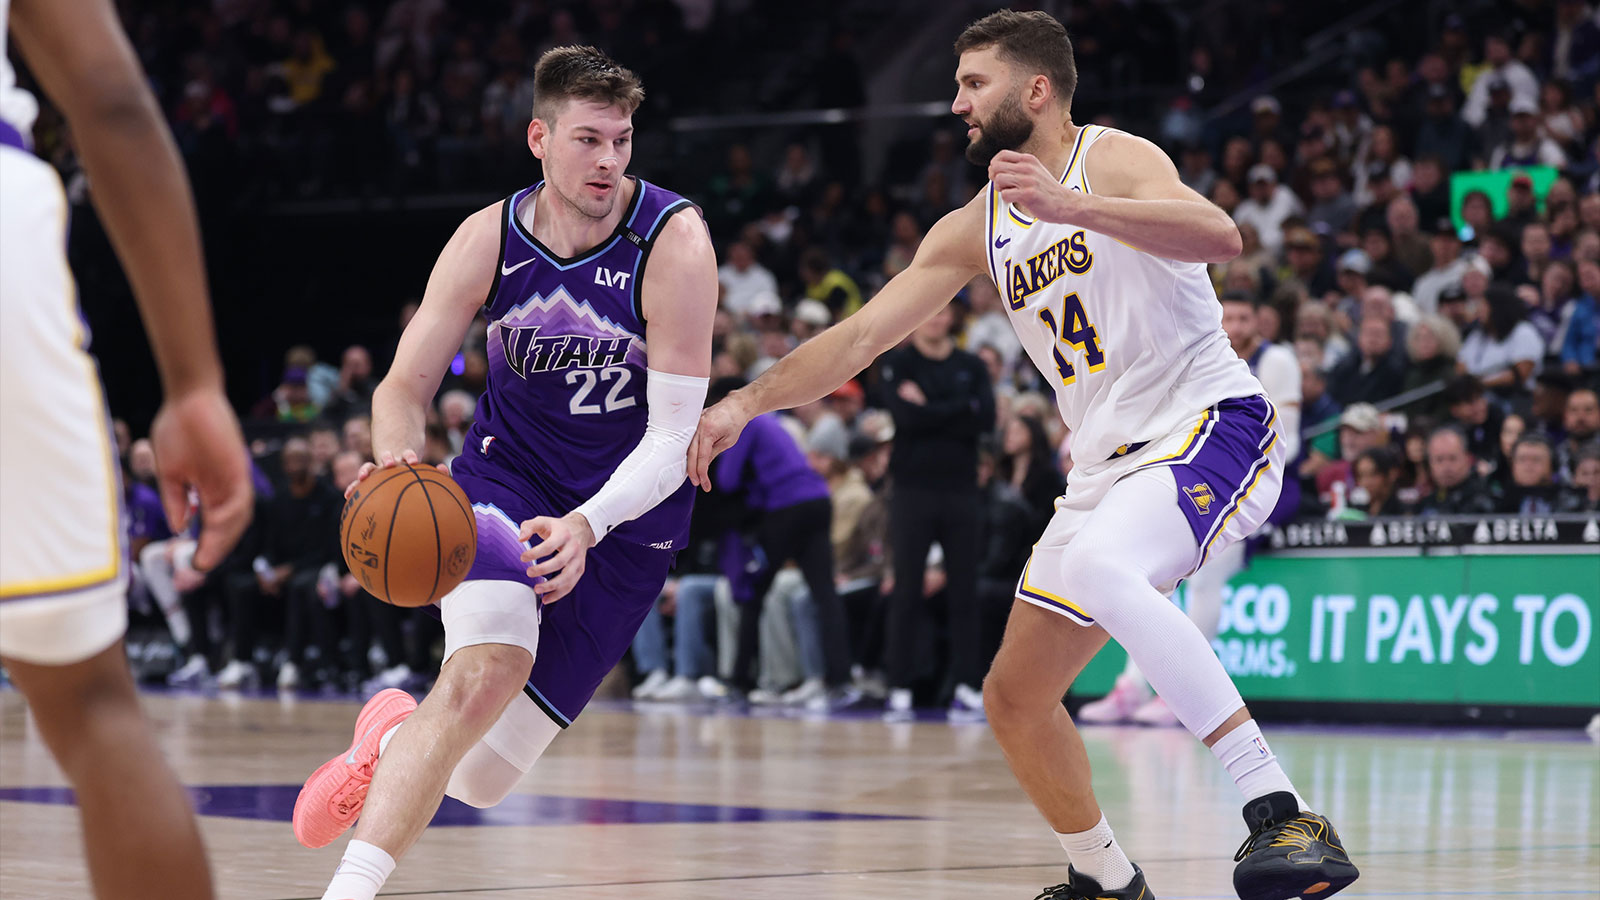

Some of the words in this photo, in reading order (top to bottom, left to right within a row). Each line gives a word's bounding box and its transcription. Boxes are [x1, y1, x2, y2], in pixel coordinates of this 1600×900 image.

[594, 266, 631, 290] LVT
[1004, 230, 1094, 312] LAKERS
[499, 324, 634, 380] UTAH
[1038, 291, 1106, 386] 14
[565, 366, 637, 415] 22
[1286, 523, 1349, 546] DELTA
[1388, 520, 1452, 544] DELTA
[1493, 518, 1558, 541] DELTA
[1309, 594, 1356, 663] IT
[1365, 592, 1499, 666] PAYS
[1513, 592, 1592, 667] TO
